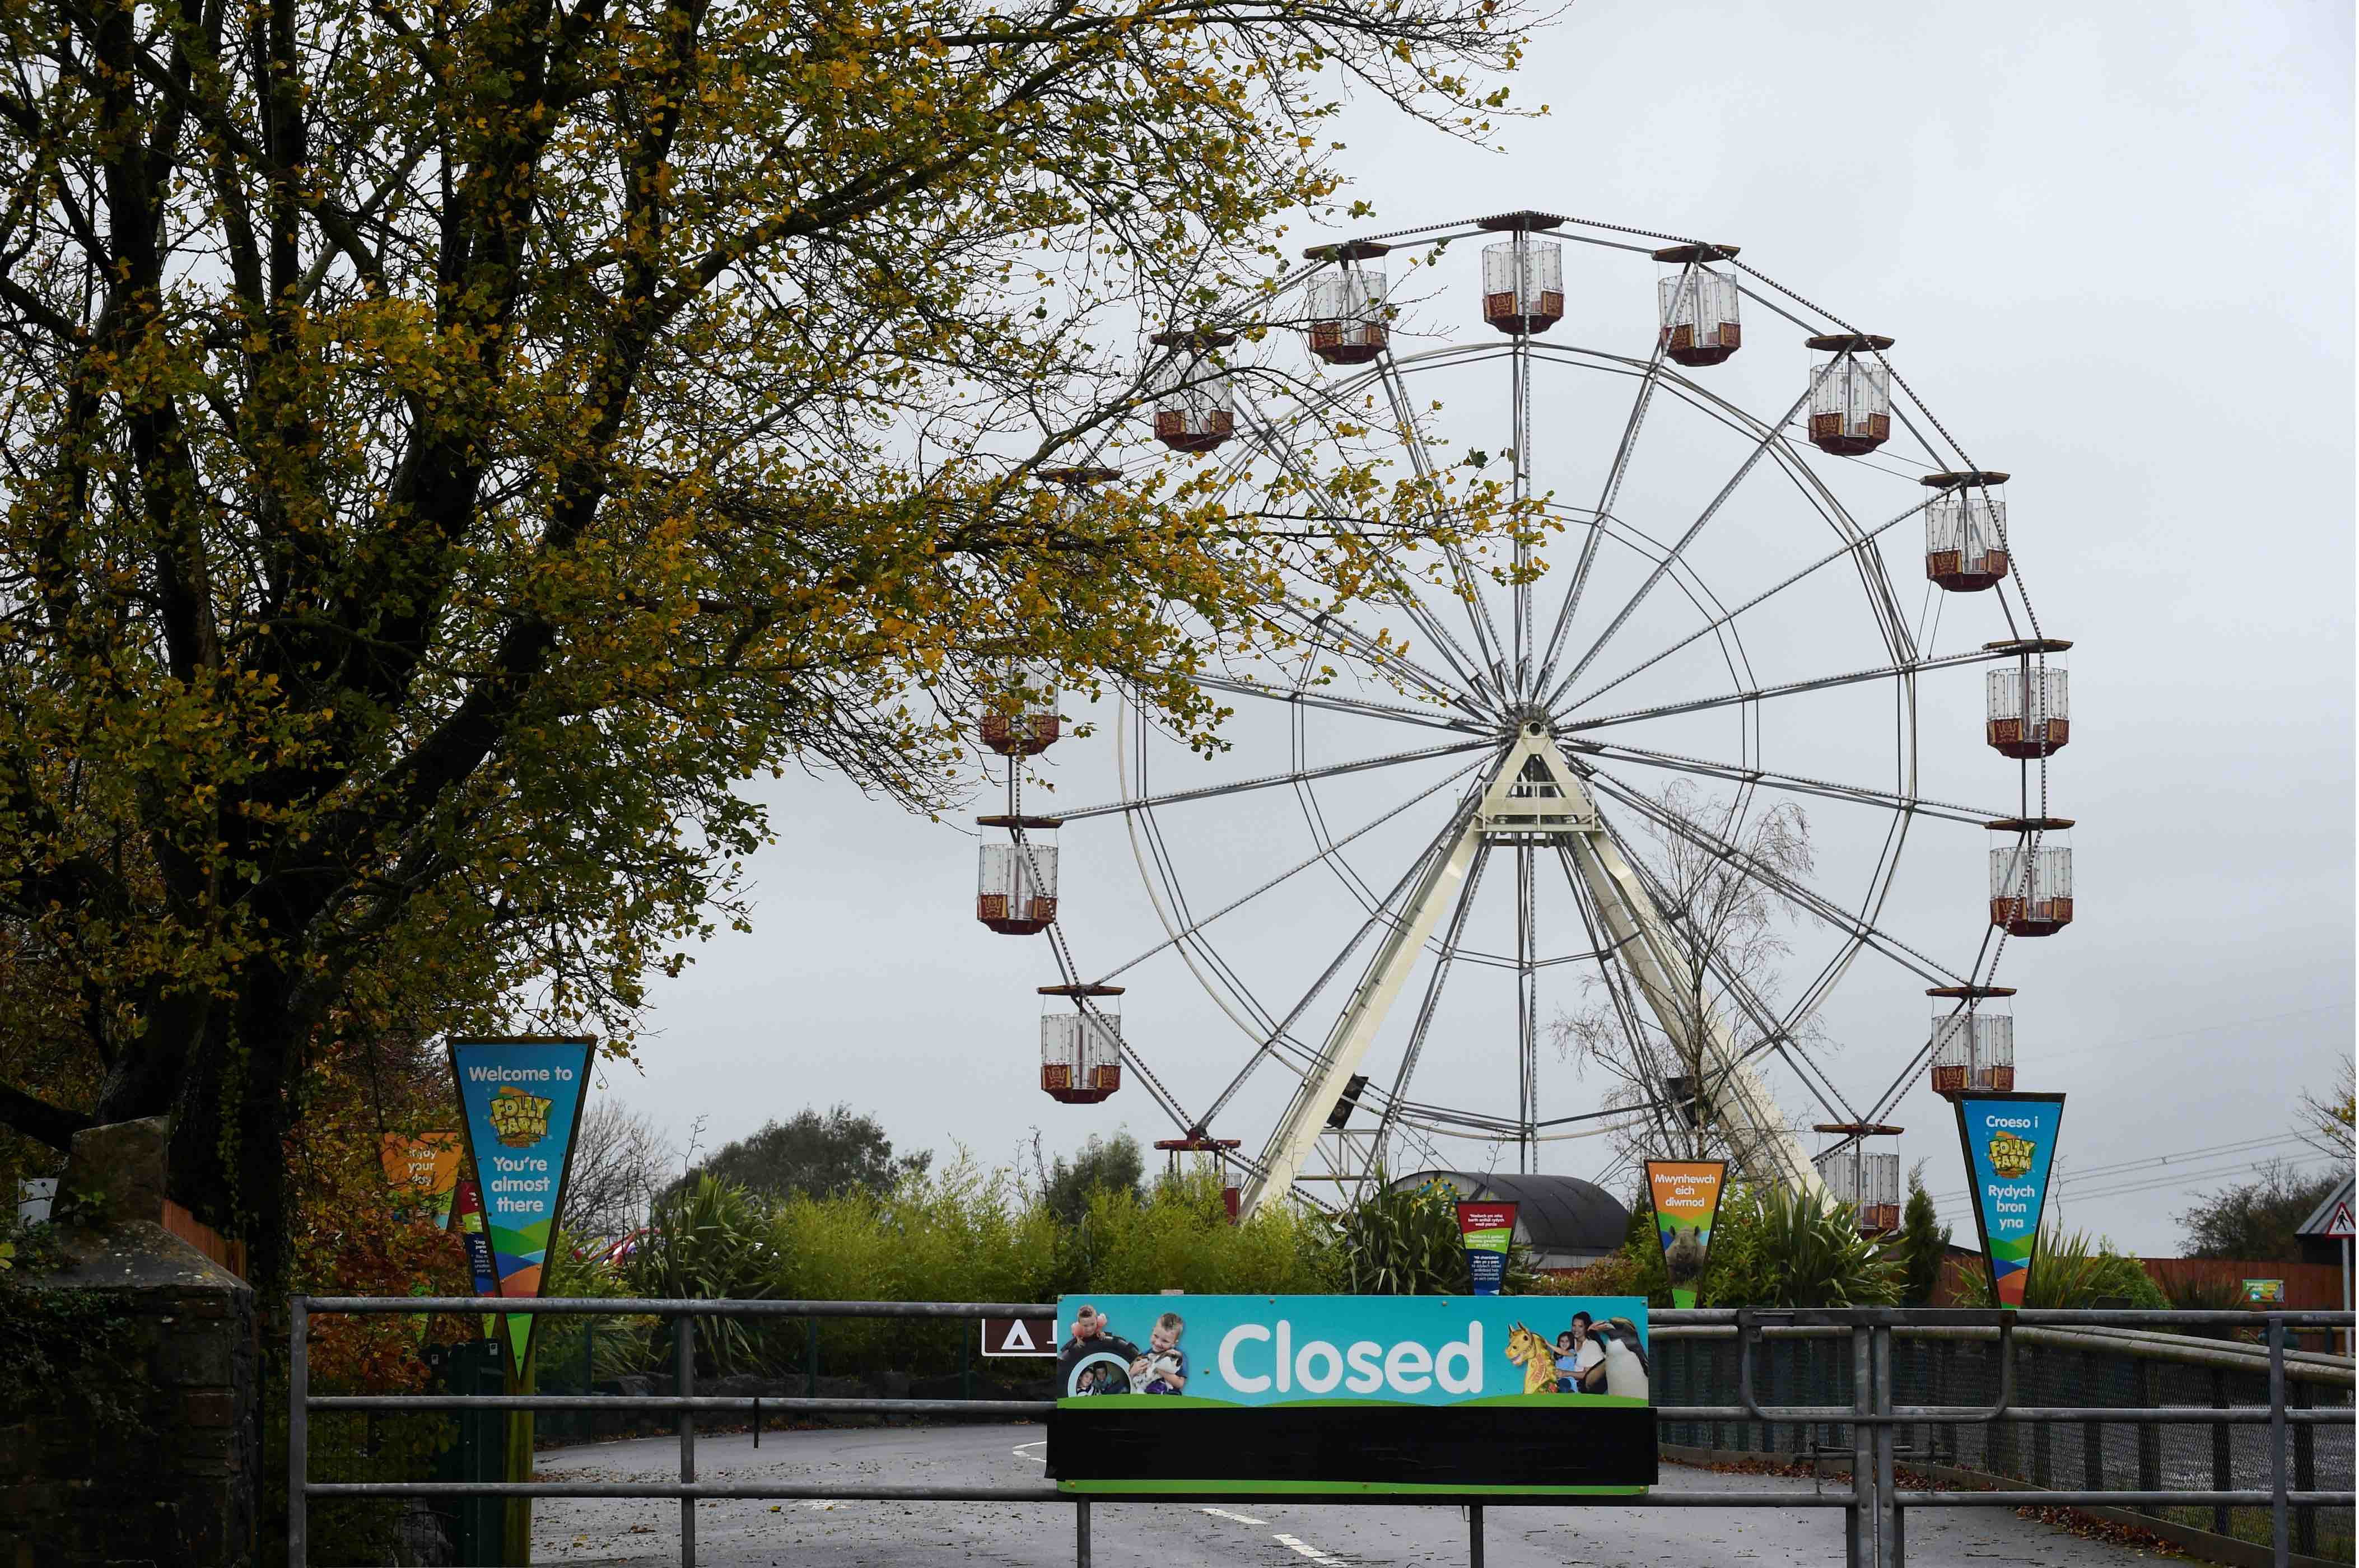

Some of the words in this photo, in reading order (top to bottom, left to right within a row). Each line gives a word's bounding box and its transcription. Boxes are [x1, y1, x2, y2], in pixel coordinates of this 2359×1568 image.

[468, 1065, 550, 1081] Welcome
[554, 1066, 574, 1081] to
[490, 1096, 553, 1120] FOLLY
[496, 1116, 547, 1136] FARM
[1985, 1115, 2031, 1128] Croeso
[2034, 1115, 2039, 1128] i
[1989, 1138, 2037, 1157] FOLLY
[408, 1162, 435, 1174] your
[492, 1156, 548, 1172] You're
[1994, 1155, 2031, 1170] FARM
[491, 1175, 551, 1193] almost
[1654, 1173, 1715, 1185] Mwynhewch
[1675, 1186, 1695, 1196] eich
[1988, 1184, 2035, 1201] Rydych
[496, 1196, 544, 1212] there
[1665, 1197, 1705, 1207] diwrnod
[1996, 1200, 2027, 1213] bron
[1999, 1217, 2024, 1231] yna
[1218, 1319, 1484, 1394] Closed
